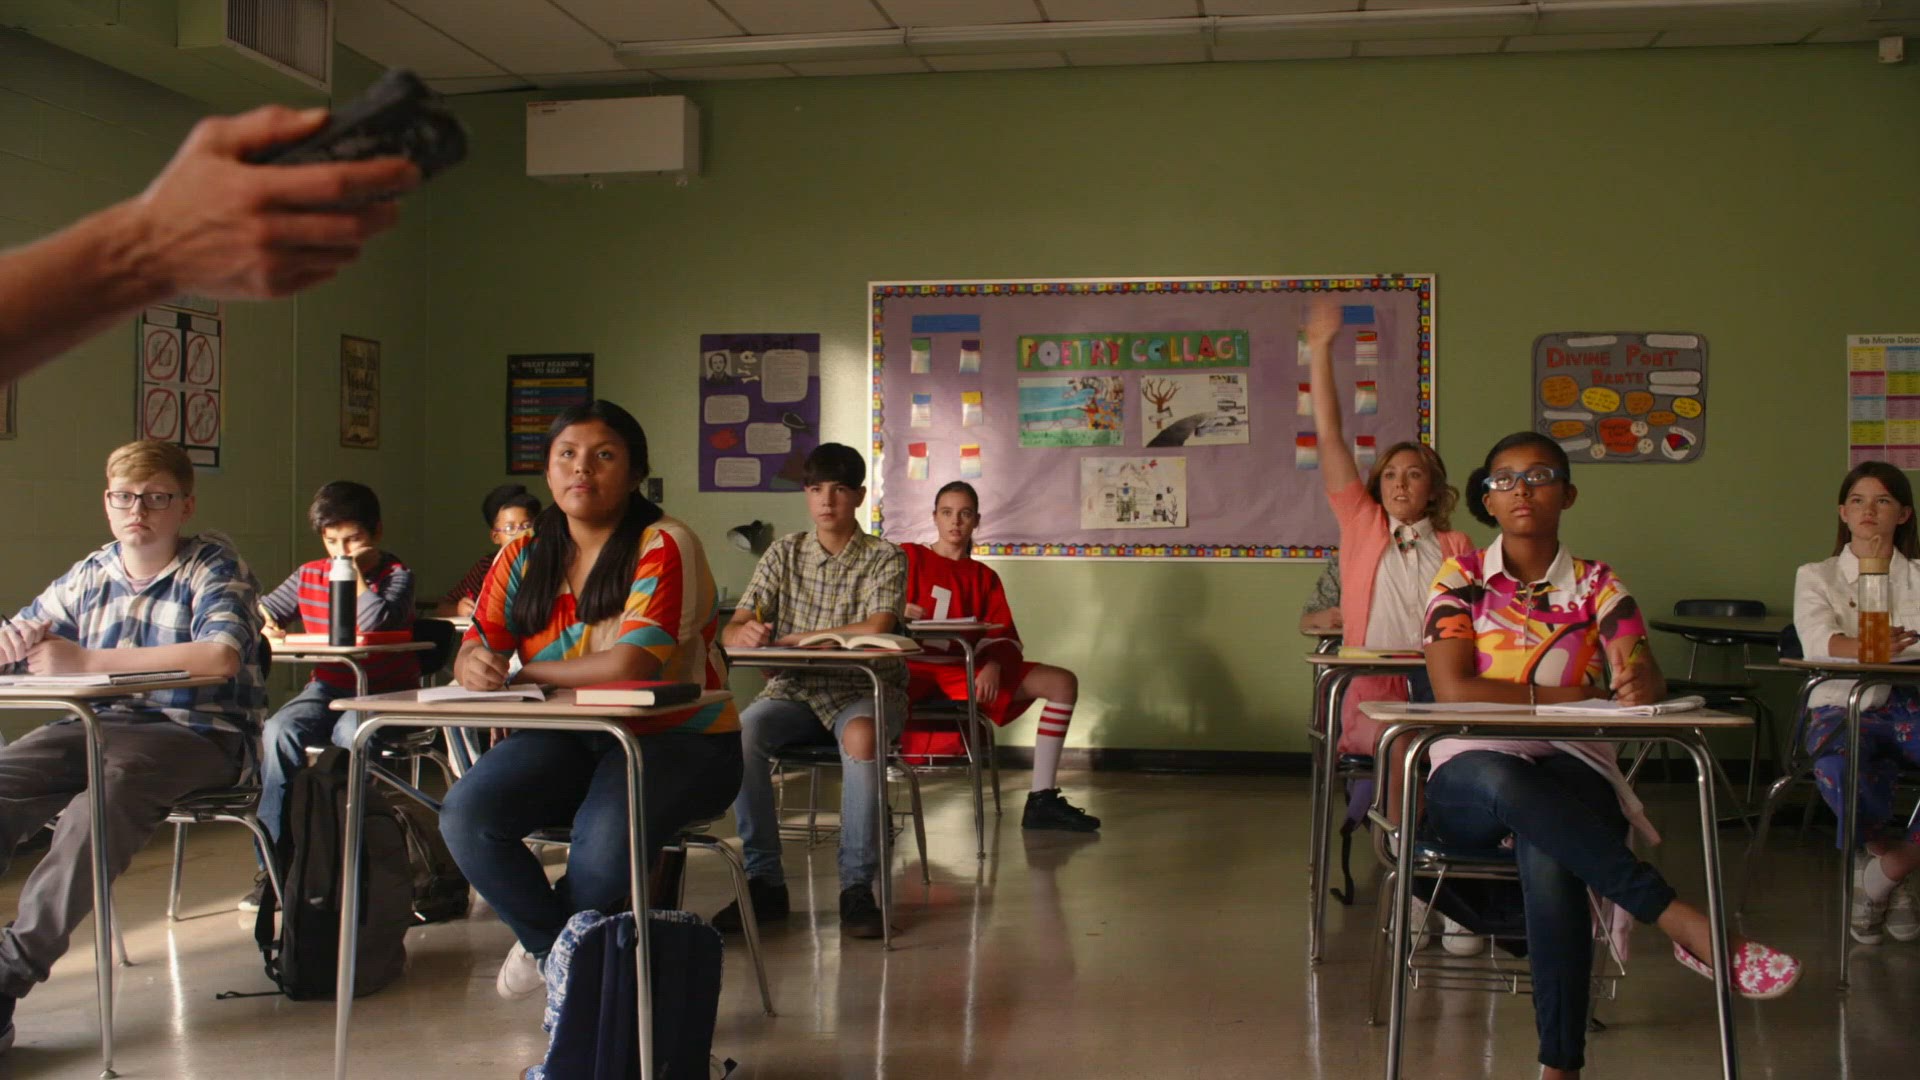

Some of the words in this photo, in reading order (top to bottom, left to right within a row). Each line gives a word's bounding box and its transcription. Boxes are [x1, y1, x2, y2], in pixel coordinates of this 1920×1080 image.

[1021, 336, 1123, 368] POETRY
[1131, 335, 1243, 363] COLLAGE
[1873, 335, 1895, 344] More
[930, 584, 953, 620] 1
